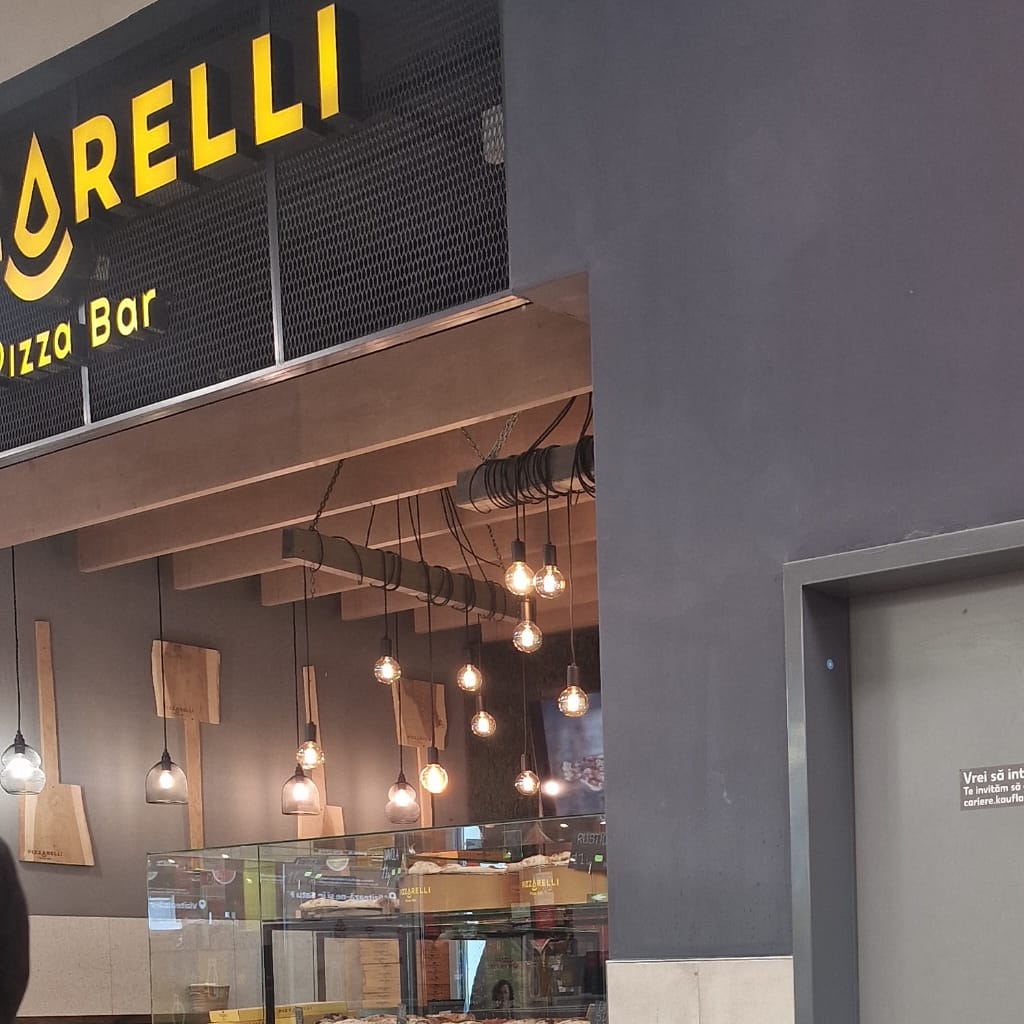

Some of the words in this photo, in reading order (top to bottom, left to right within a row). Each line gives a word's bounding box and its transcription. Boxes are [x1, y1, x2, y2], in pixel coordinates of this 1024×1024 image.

[0, 3, 340, 302] ARELLI
[90, 288, 157, 348] Bar
[962, 771, 988, 785] Vrei
[990, 768, 1005, 782] să
[962, 785, 974, 796] Te
[975, 780, 1008, 795] invităm
[1010, 781, 1022, 792] să
